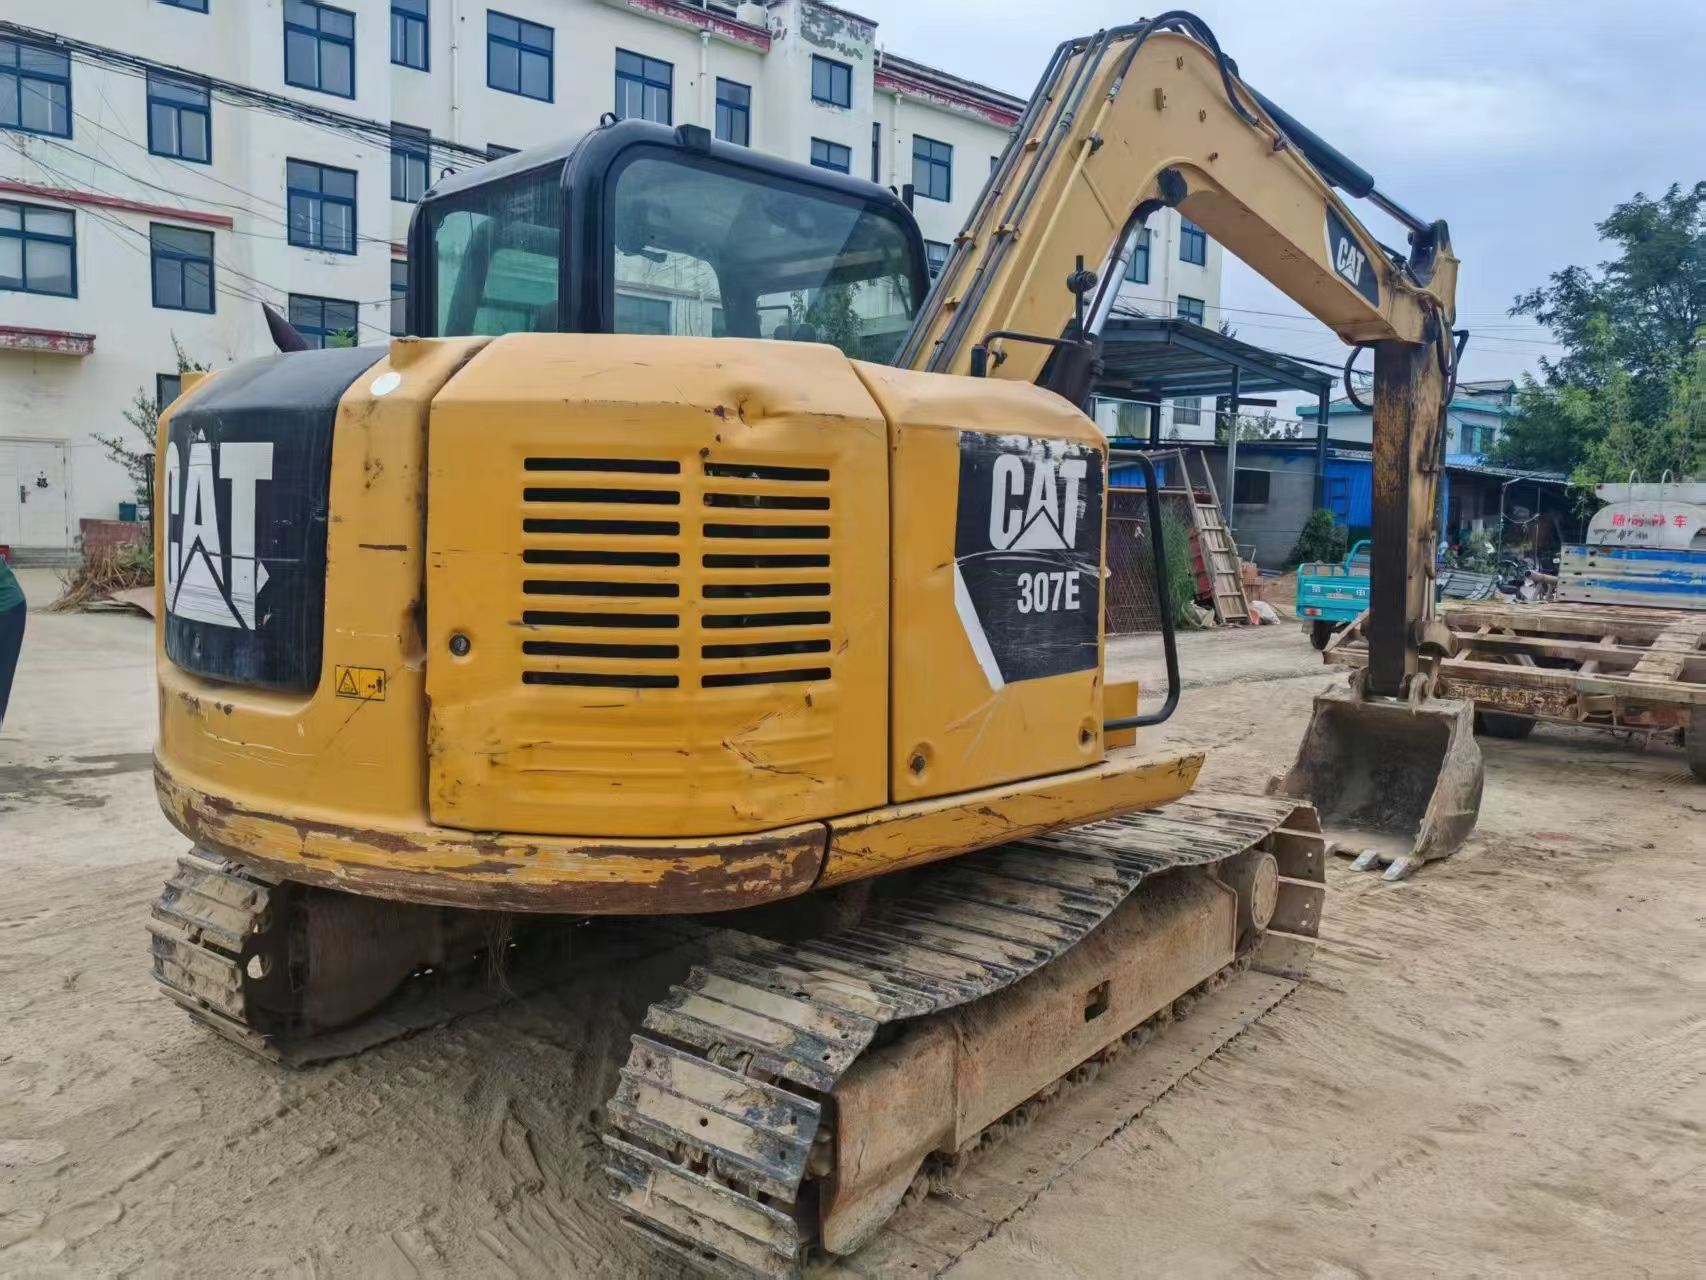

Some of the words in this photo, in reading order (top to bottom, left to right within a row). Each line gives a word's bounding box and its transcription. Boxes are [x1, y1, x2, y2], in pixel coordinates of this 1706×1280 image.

[1337, 237, 1365, 286] CAT
[164, 441, 274, 630] CAT
[990, 454, 1087, 550] CAT
[1017, 571, 1080, 613] 307E
